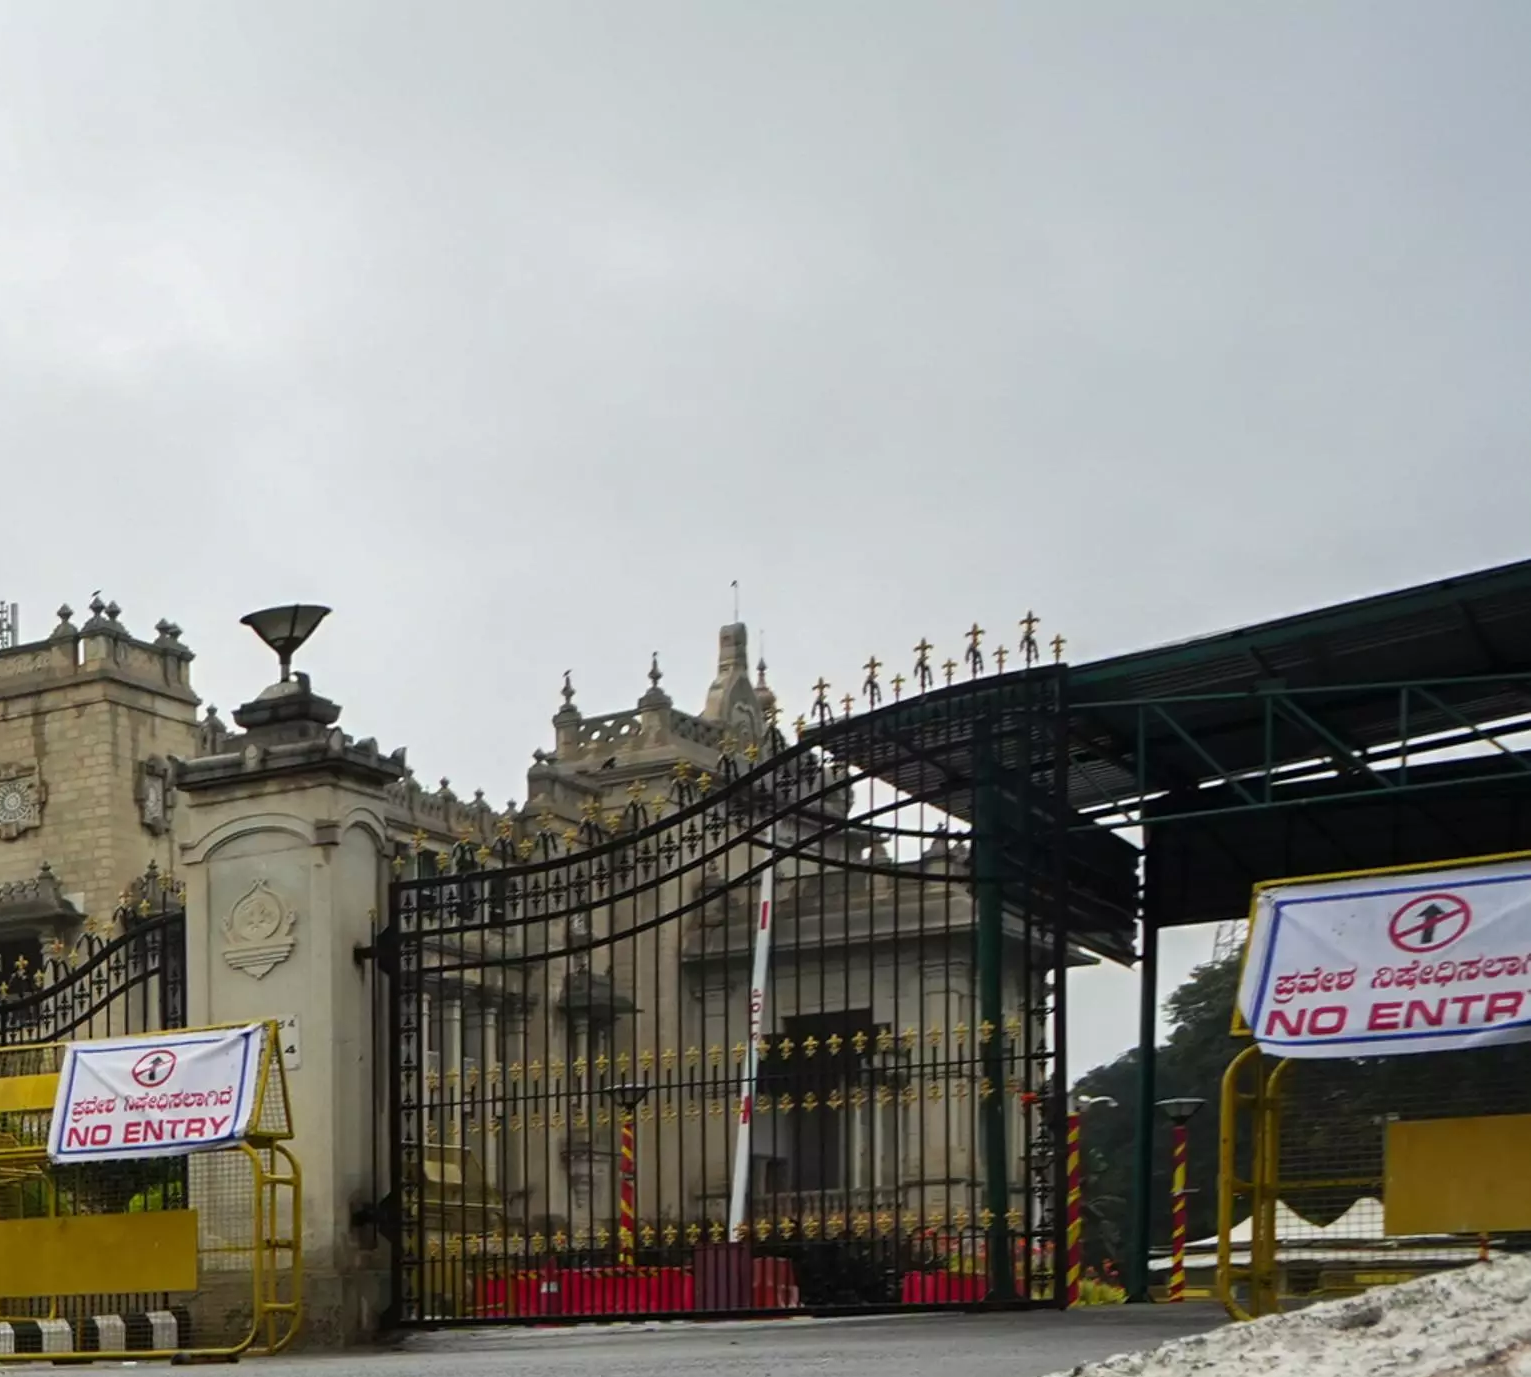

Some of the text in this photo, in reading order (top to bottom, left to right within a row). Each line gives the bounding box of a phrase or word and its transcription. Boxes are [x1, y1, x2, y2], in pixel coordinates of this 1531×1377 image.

[1273, 965, 1357, 1004] ಪ್ರವೇಶ
[1264, 989, 1531, 1037] NO ENTR
[72, 1096, 117, 1123] ಪ್ರವೇಶ
[67, 1115, 230, 1148] NO ENTRY
